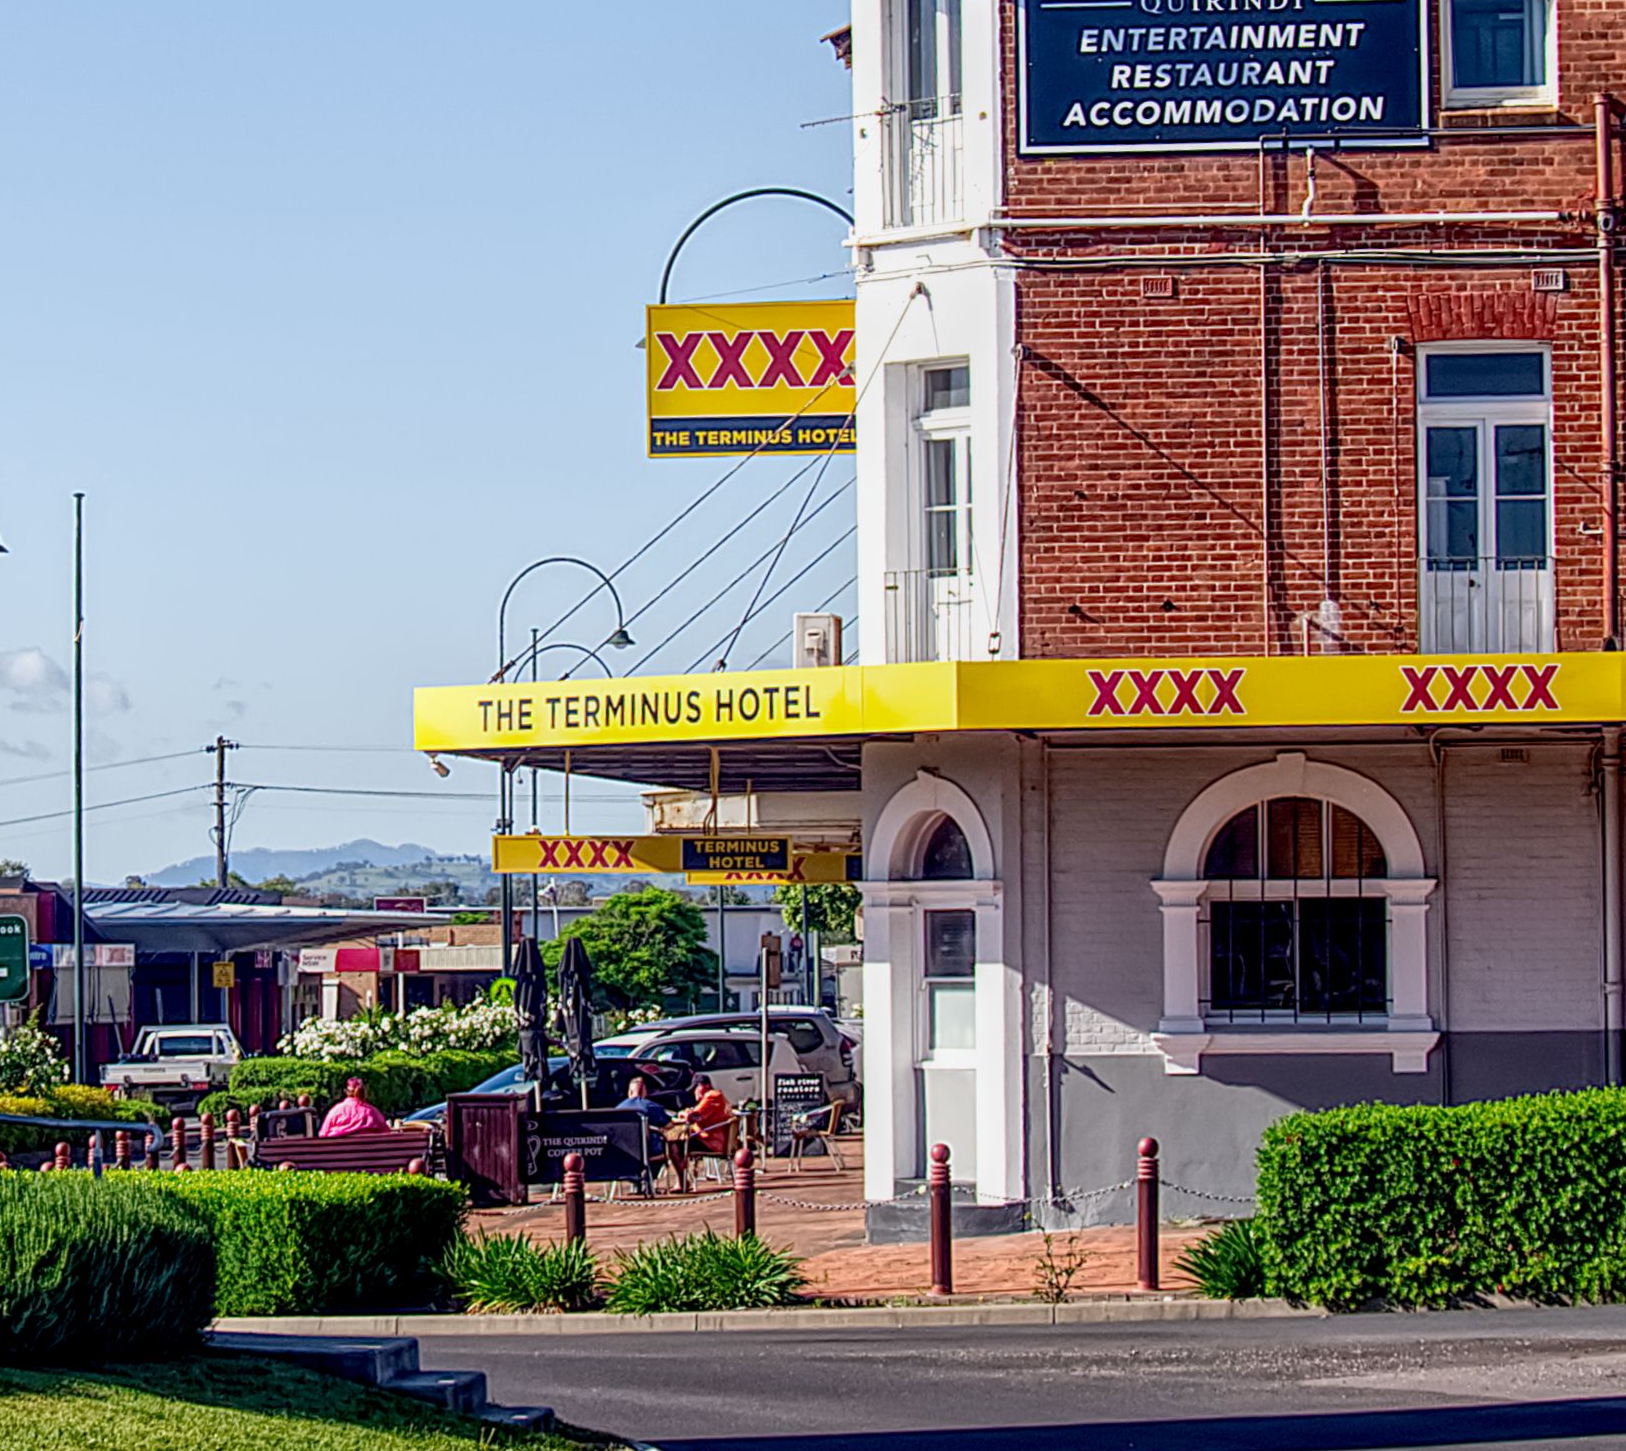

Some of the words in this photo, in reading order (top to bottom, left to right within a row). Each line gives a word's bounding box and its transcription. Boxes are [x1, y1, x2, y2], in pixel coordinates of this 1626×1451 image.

[1080, 23, 1365, 53] ENTERTAINMENT
[1111, 60, 1336, 90] RESTAURANT
[1063, 95, 1384, 127] ACCOMMODATION
[654, 329, 856, 391] XXXX
[653, 431, 690, 446] THE
[695, 429, 793, 446] TERMINUS
[798, 428, 857, 444] HOTEL
[1086, 667, 1247, 716] XXXX
[1400, 663, 1561, 713] XXXX
[477, 699, 533, 732] THE
[545, 690, 701, 730] TERMINUS
[715, 684, 820, 722] HOTEL
[538, 839, 636, 868] XXXX
[694, 840, 780, 854] TERMINUS
[708, 855, 765, 869] HOTEL
[777, 1078, 796, 1086] fish
[777, 1085, 820, 1093] roasters
[542, 1137, 562, 1146] THE
[563, 1135, 607, 1147] QUIRINDI
[585, 1147, 604, 1156] POT
